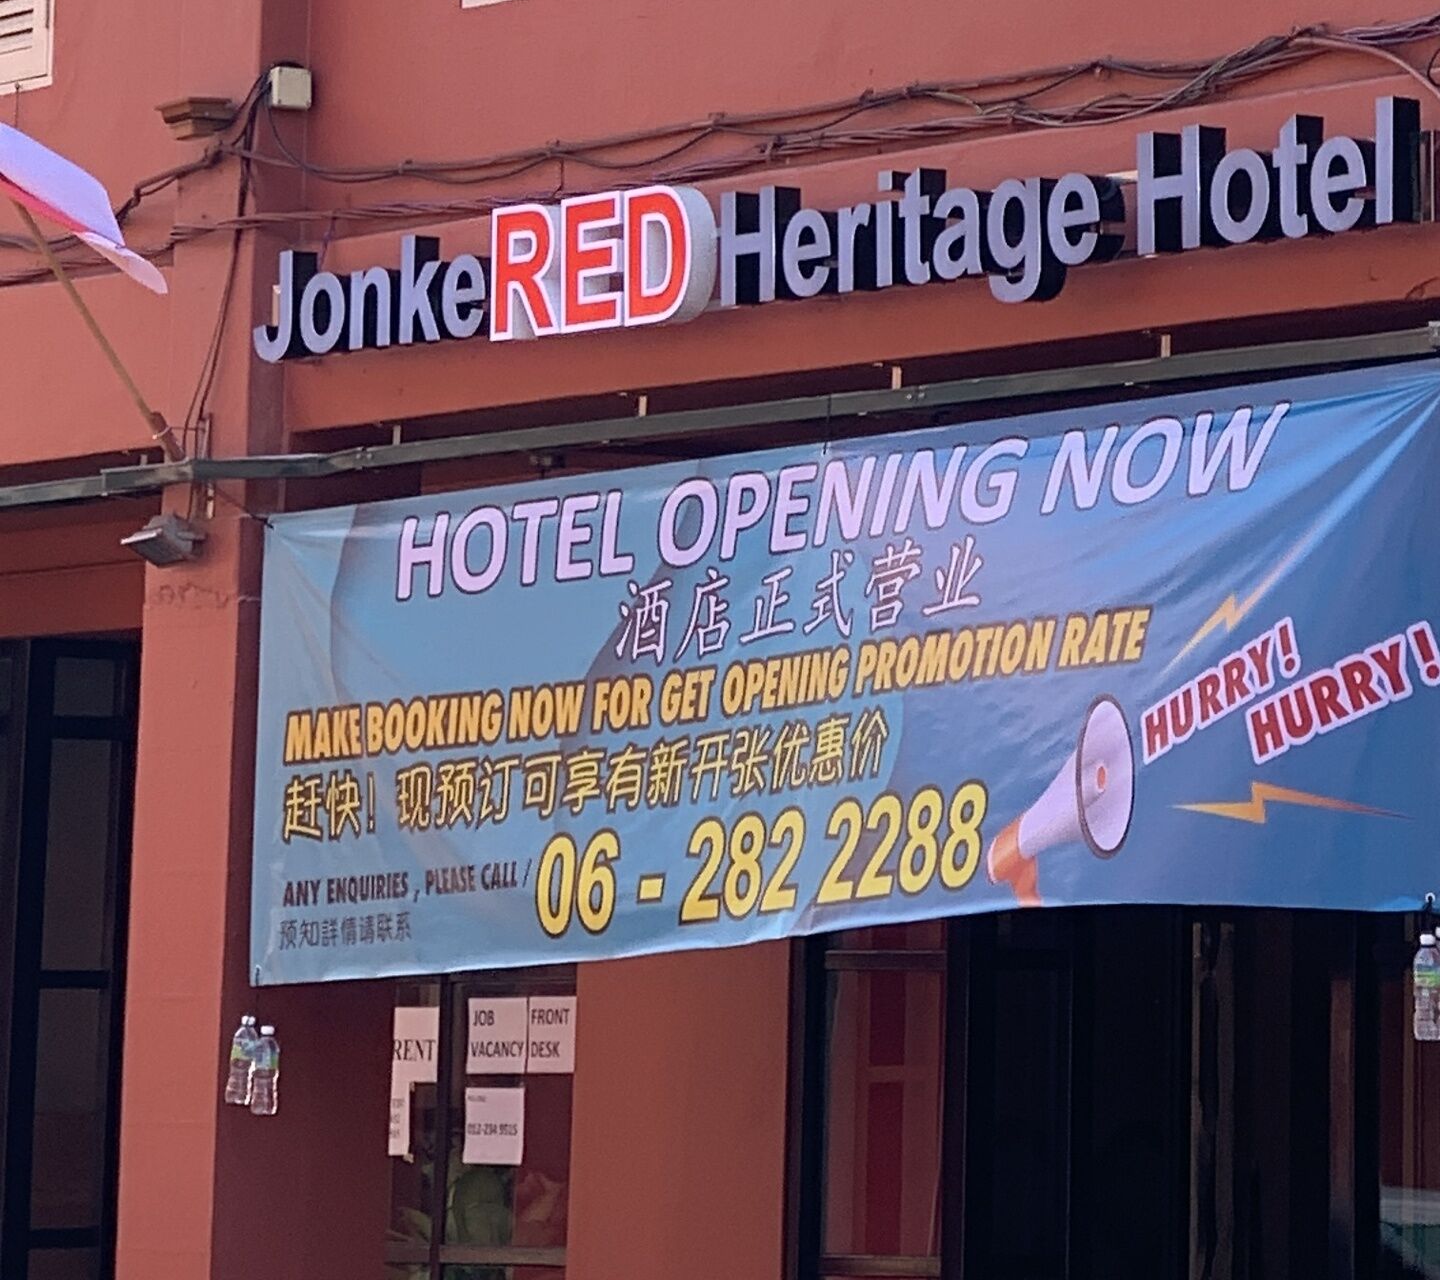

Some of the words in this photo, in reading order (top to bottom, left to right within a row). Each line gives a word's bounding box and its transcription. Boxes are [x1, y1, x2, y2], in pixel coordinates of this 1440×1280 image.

[253, 185, 692, 362] JonkeRED
[720, 168, 1099, 304] Heritage
[1137, 95, 1394, 257] Hotel
[395, 488, 636, 602] HOTEL
[657, 438, 1029, 569] OPENING
[1040, 401, 1292, 516] NOW
[615, 536, 984, 664] 酒店正式营业
[283, 705, 363, 763] MAKE
[365, 693, 503, 753] BOOKING
[507, 682, 586, 739] NOW
[593, 673, 650, 730] FOR
[659, 665, 716, 723] GET
[721, 650, 849, 715] OPENING
[853, 618, 1057, 696] PROMOTION
[1058, 607, 1153, 668] RATE
[1140, 616, 1302, 765] HURRY!
[283, 878, 321, 908] ANY
[425, 864, 477, 896] PLEASE
[481, 860, 518, 890] CALL
[535, 828, 620, 936] 06
[680, 808, 806, 925] 282
[817, 780, 988, 903] 2288
[394, 1039, 437, 1061] RENT
[471, 1041, 525, 1059] VACANCY
[473, 1009, 496, 1027] JOB
[531, 1008, 570, 1026] FRONT
[531, 1041, 560, 1058] DESK
